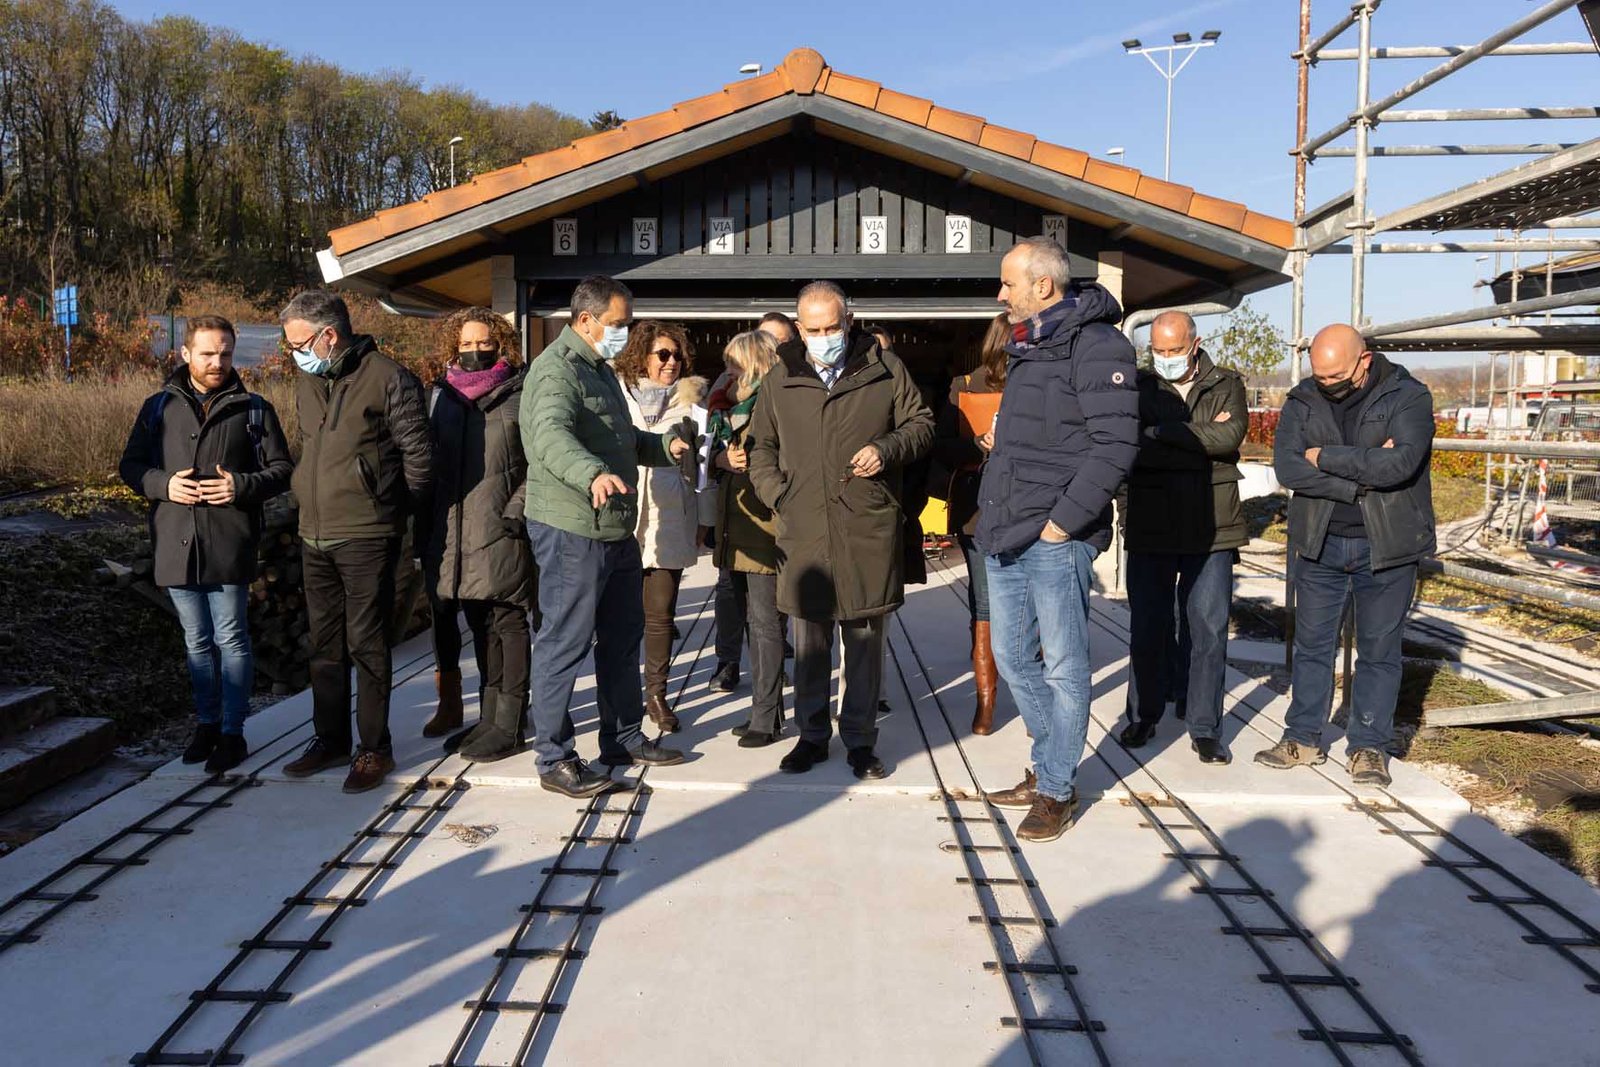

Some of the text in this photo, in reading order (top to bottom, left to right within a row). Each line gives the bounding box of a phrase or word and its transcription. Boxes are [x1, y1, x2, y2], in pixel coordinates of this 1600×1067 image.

[556, 223, 575, 233] VIA
[635, 222, 654, 232] VIA
[712, 221, 731, 231] VIA
[865, 221, 884, 231] VIA
[949, 220, 968, 230] VIA
[1045, 220, 1065, 230] VIA
[560, 234, 571, 251] 6
[639, 233, 650, 250] 5
[716, 233, 727, 250] 4
[869, 232, 880, 249] 3
[953, 231, 964, 249] 2
